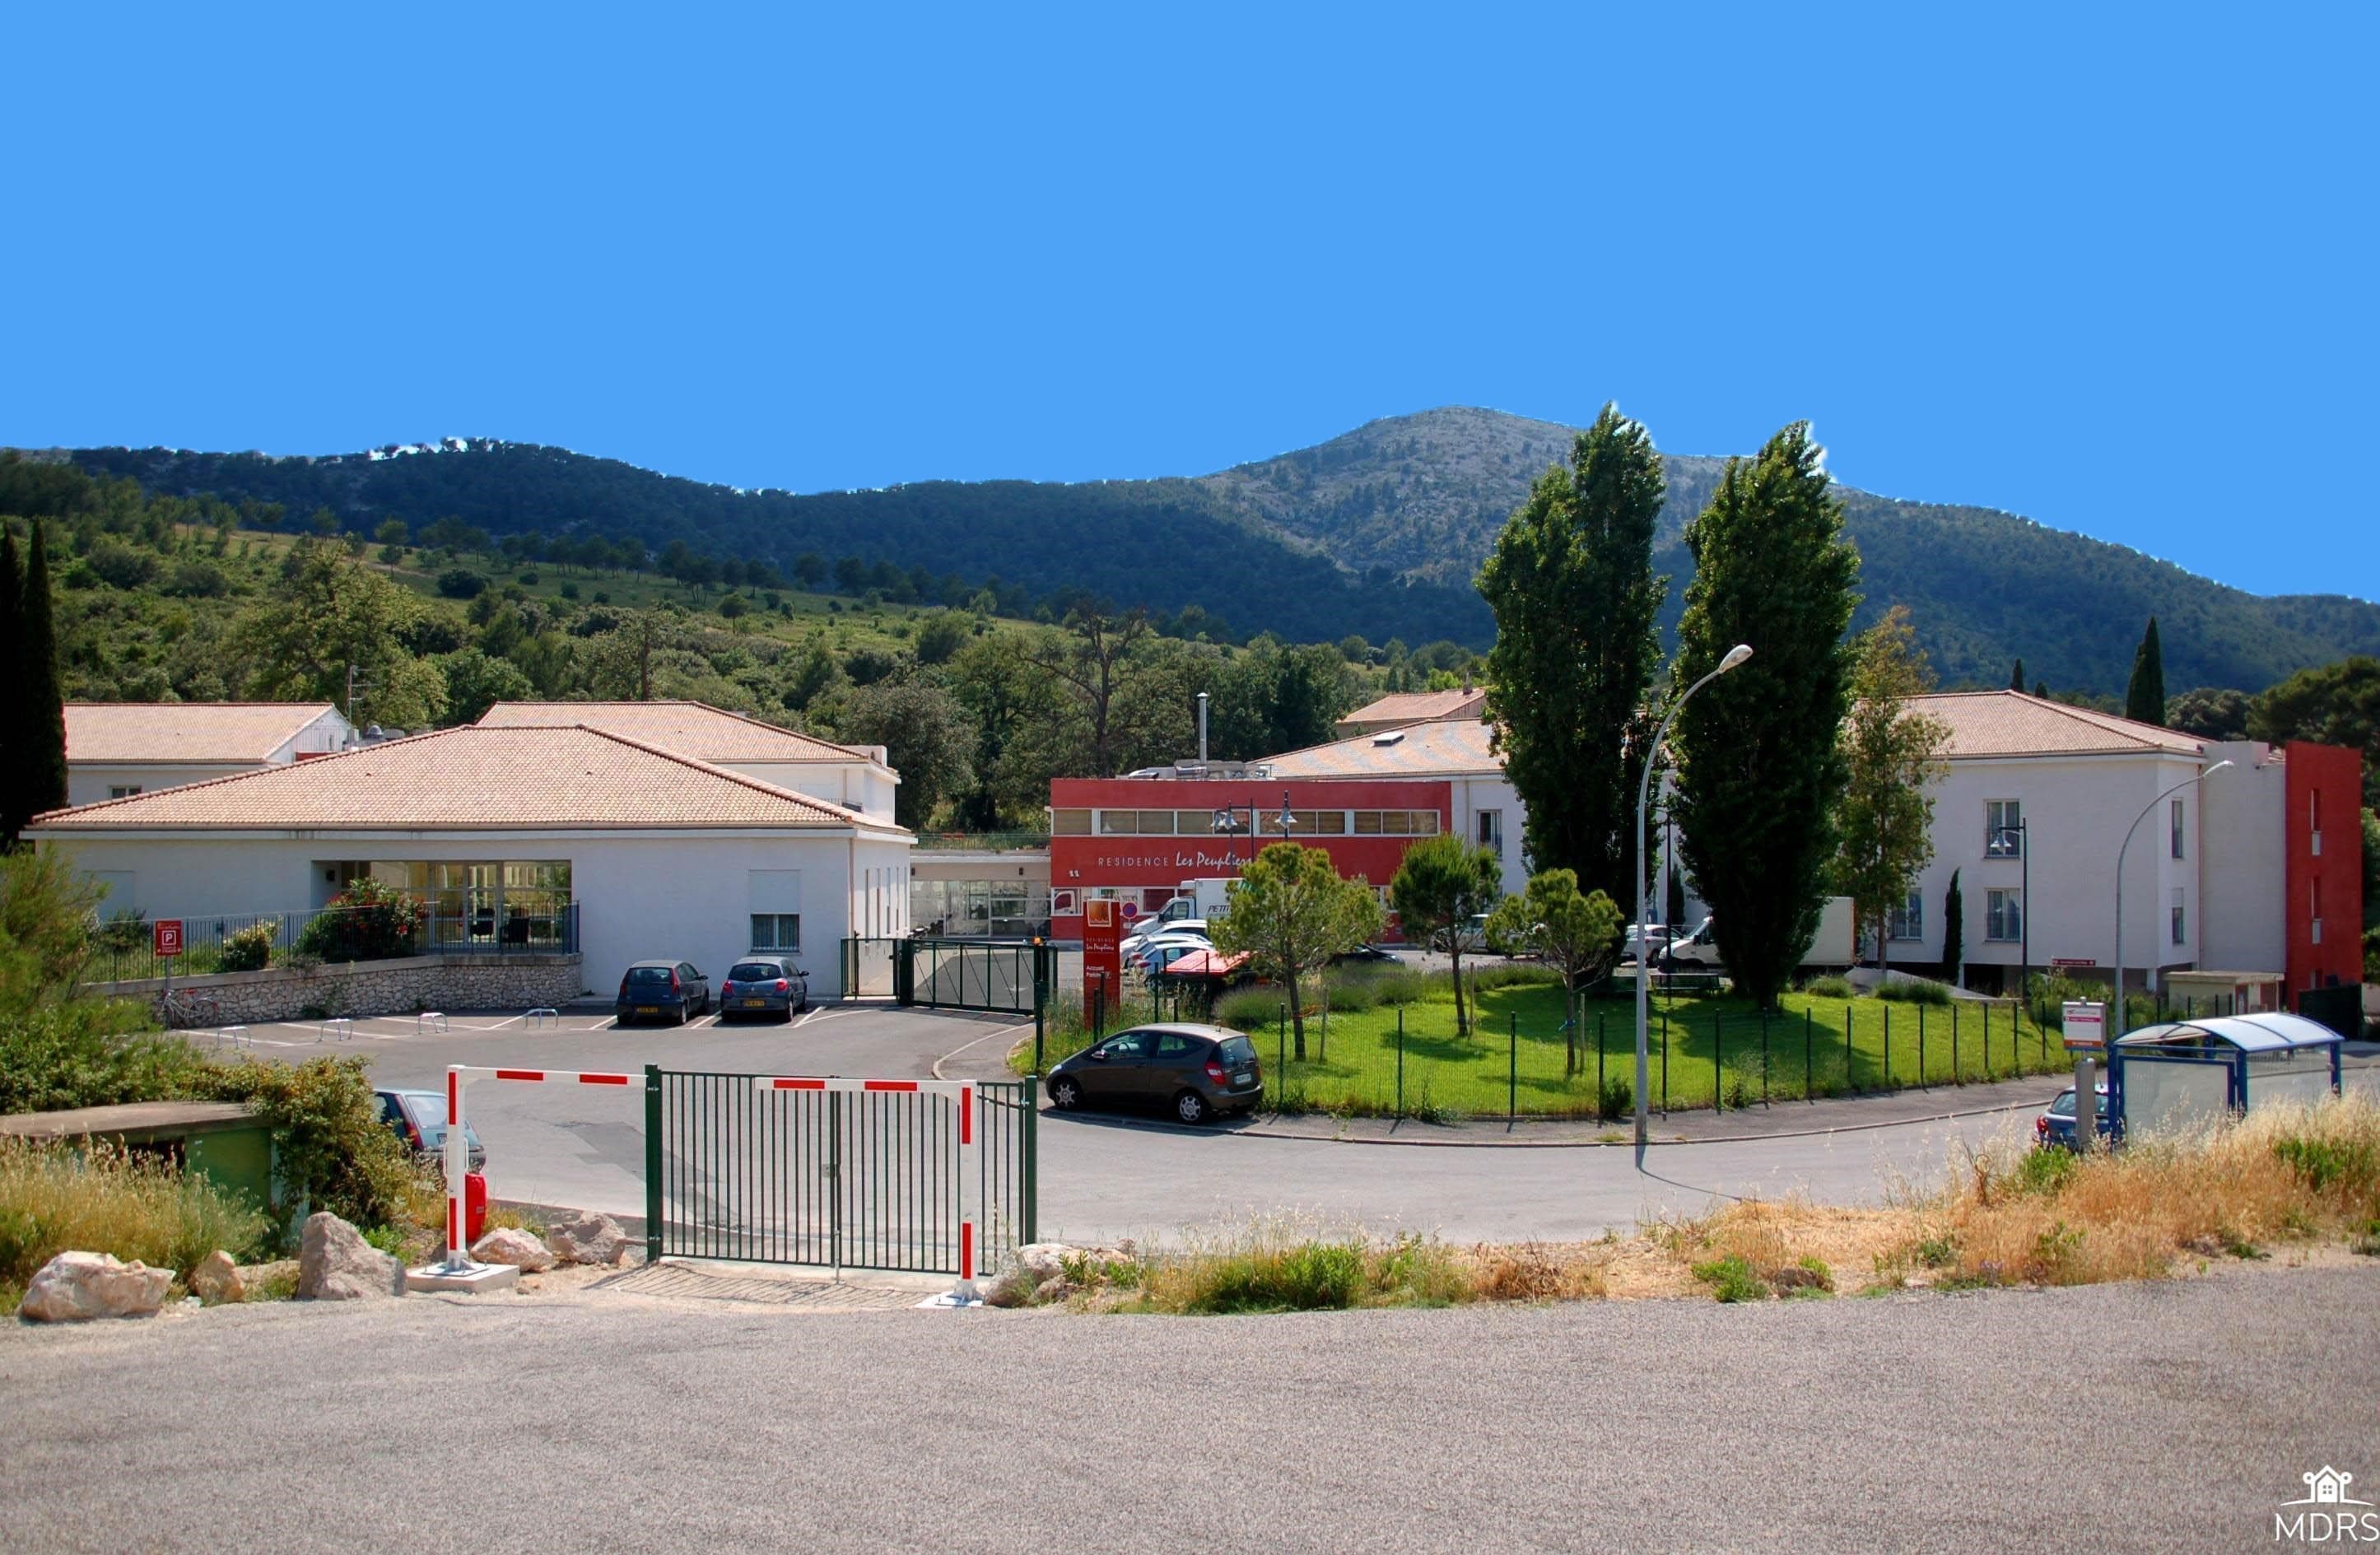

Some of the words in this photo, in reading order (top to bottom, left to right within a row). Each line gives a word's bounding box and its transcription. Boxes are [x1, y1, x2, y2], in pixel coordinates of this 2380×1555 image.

[1098, 857, 1169, 867] RESIDENCE
[1176, 850, 1194, 867] Les
[1196, 850, 1252, 871] Peupliers
